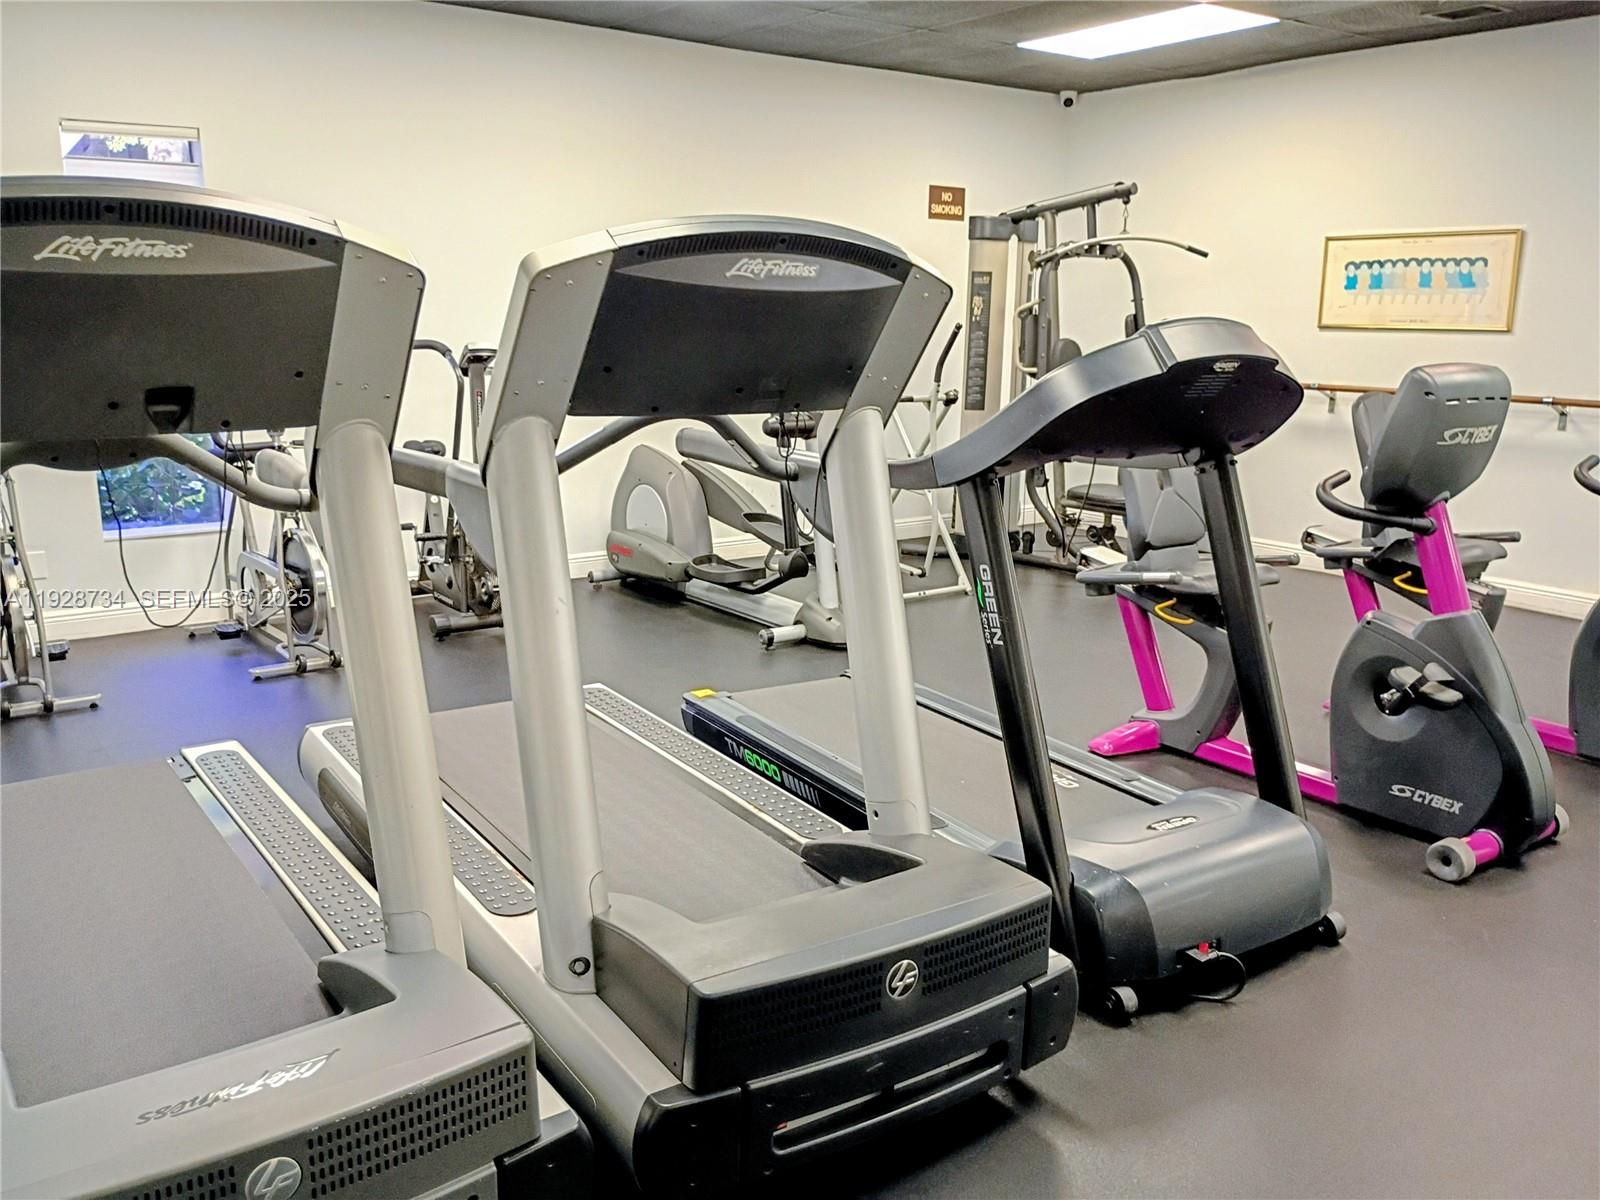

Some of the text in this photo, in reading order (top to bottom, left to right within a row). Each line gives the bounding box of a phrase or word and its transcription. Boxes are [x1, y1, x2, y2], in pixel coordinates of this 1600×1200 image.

[930, 203, 963, 216] SMOKING
[941, 191, 953, 202] NO
[979, 563, 1004, 646] GREEN
[724, 736, 782, 783] TM6000
